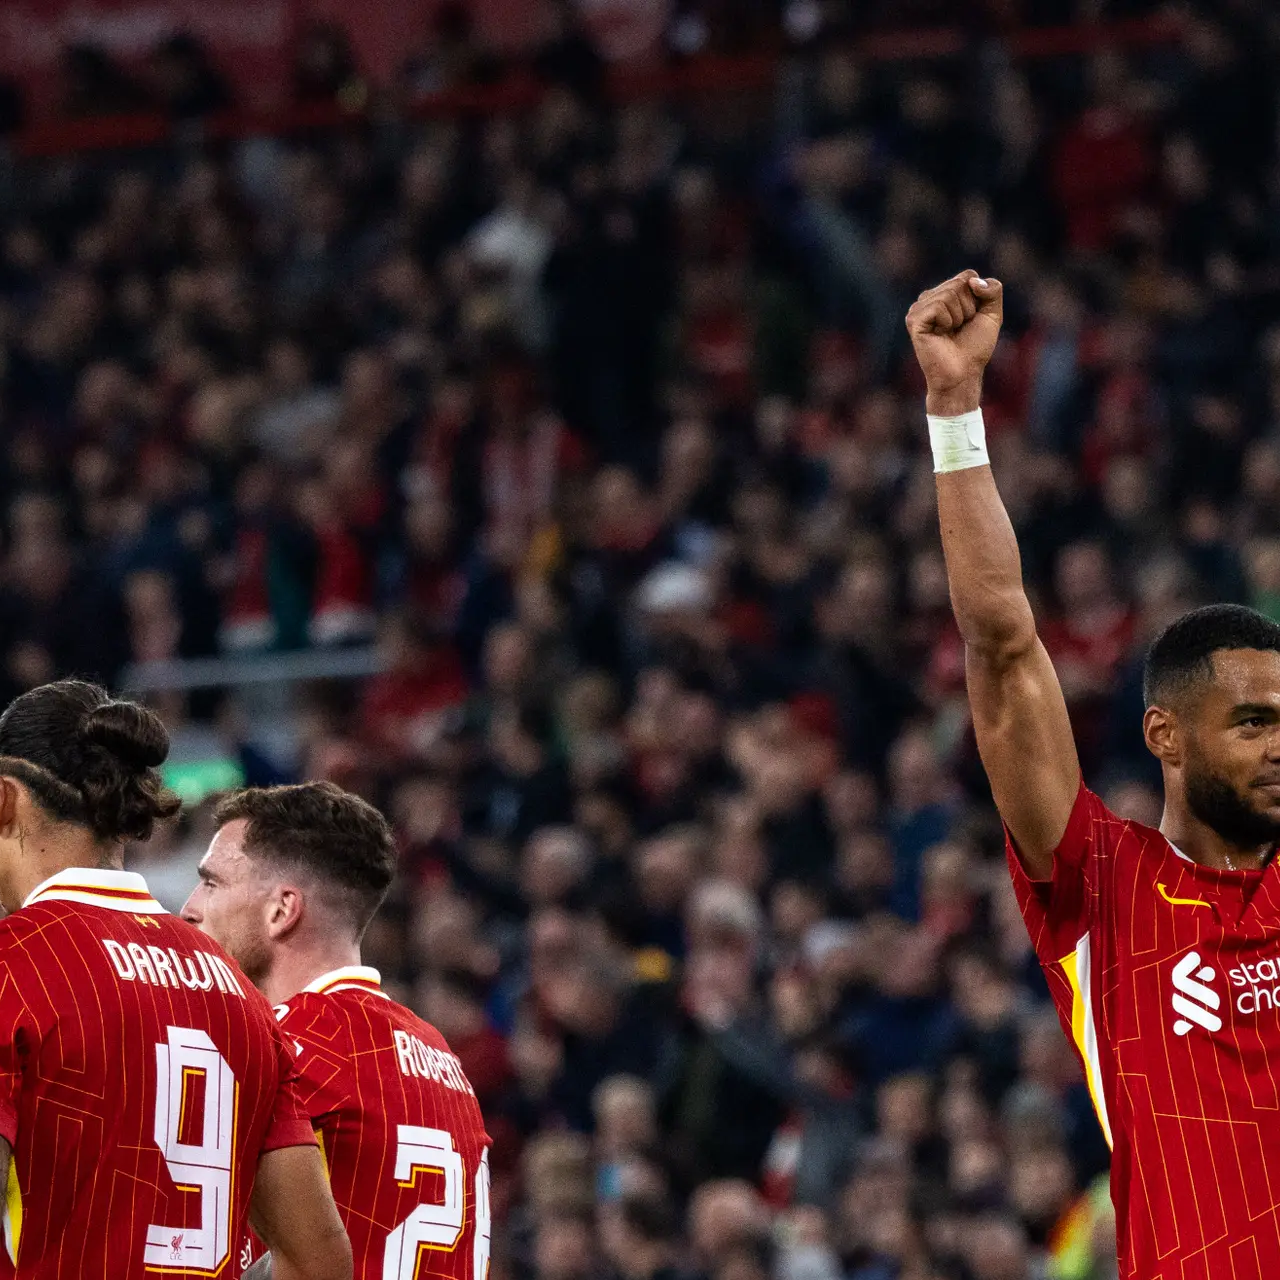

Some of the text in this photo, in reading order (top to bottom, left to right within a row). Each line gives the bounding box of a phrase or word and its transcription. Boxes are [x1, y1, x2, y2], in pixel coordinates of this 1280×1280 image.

[102, 938, 247, 1000] DARWIN
[393, 1030, 475, 1097] ROBERT
[143, 1025, 239, 1277] 9
